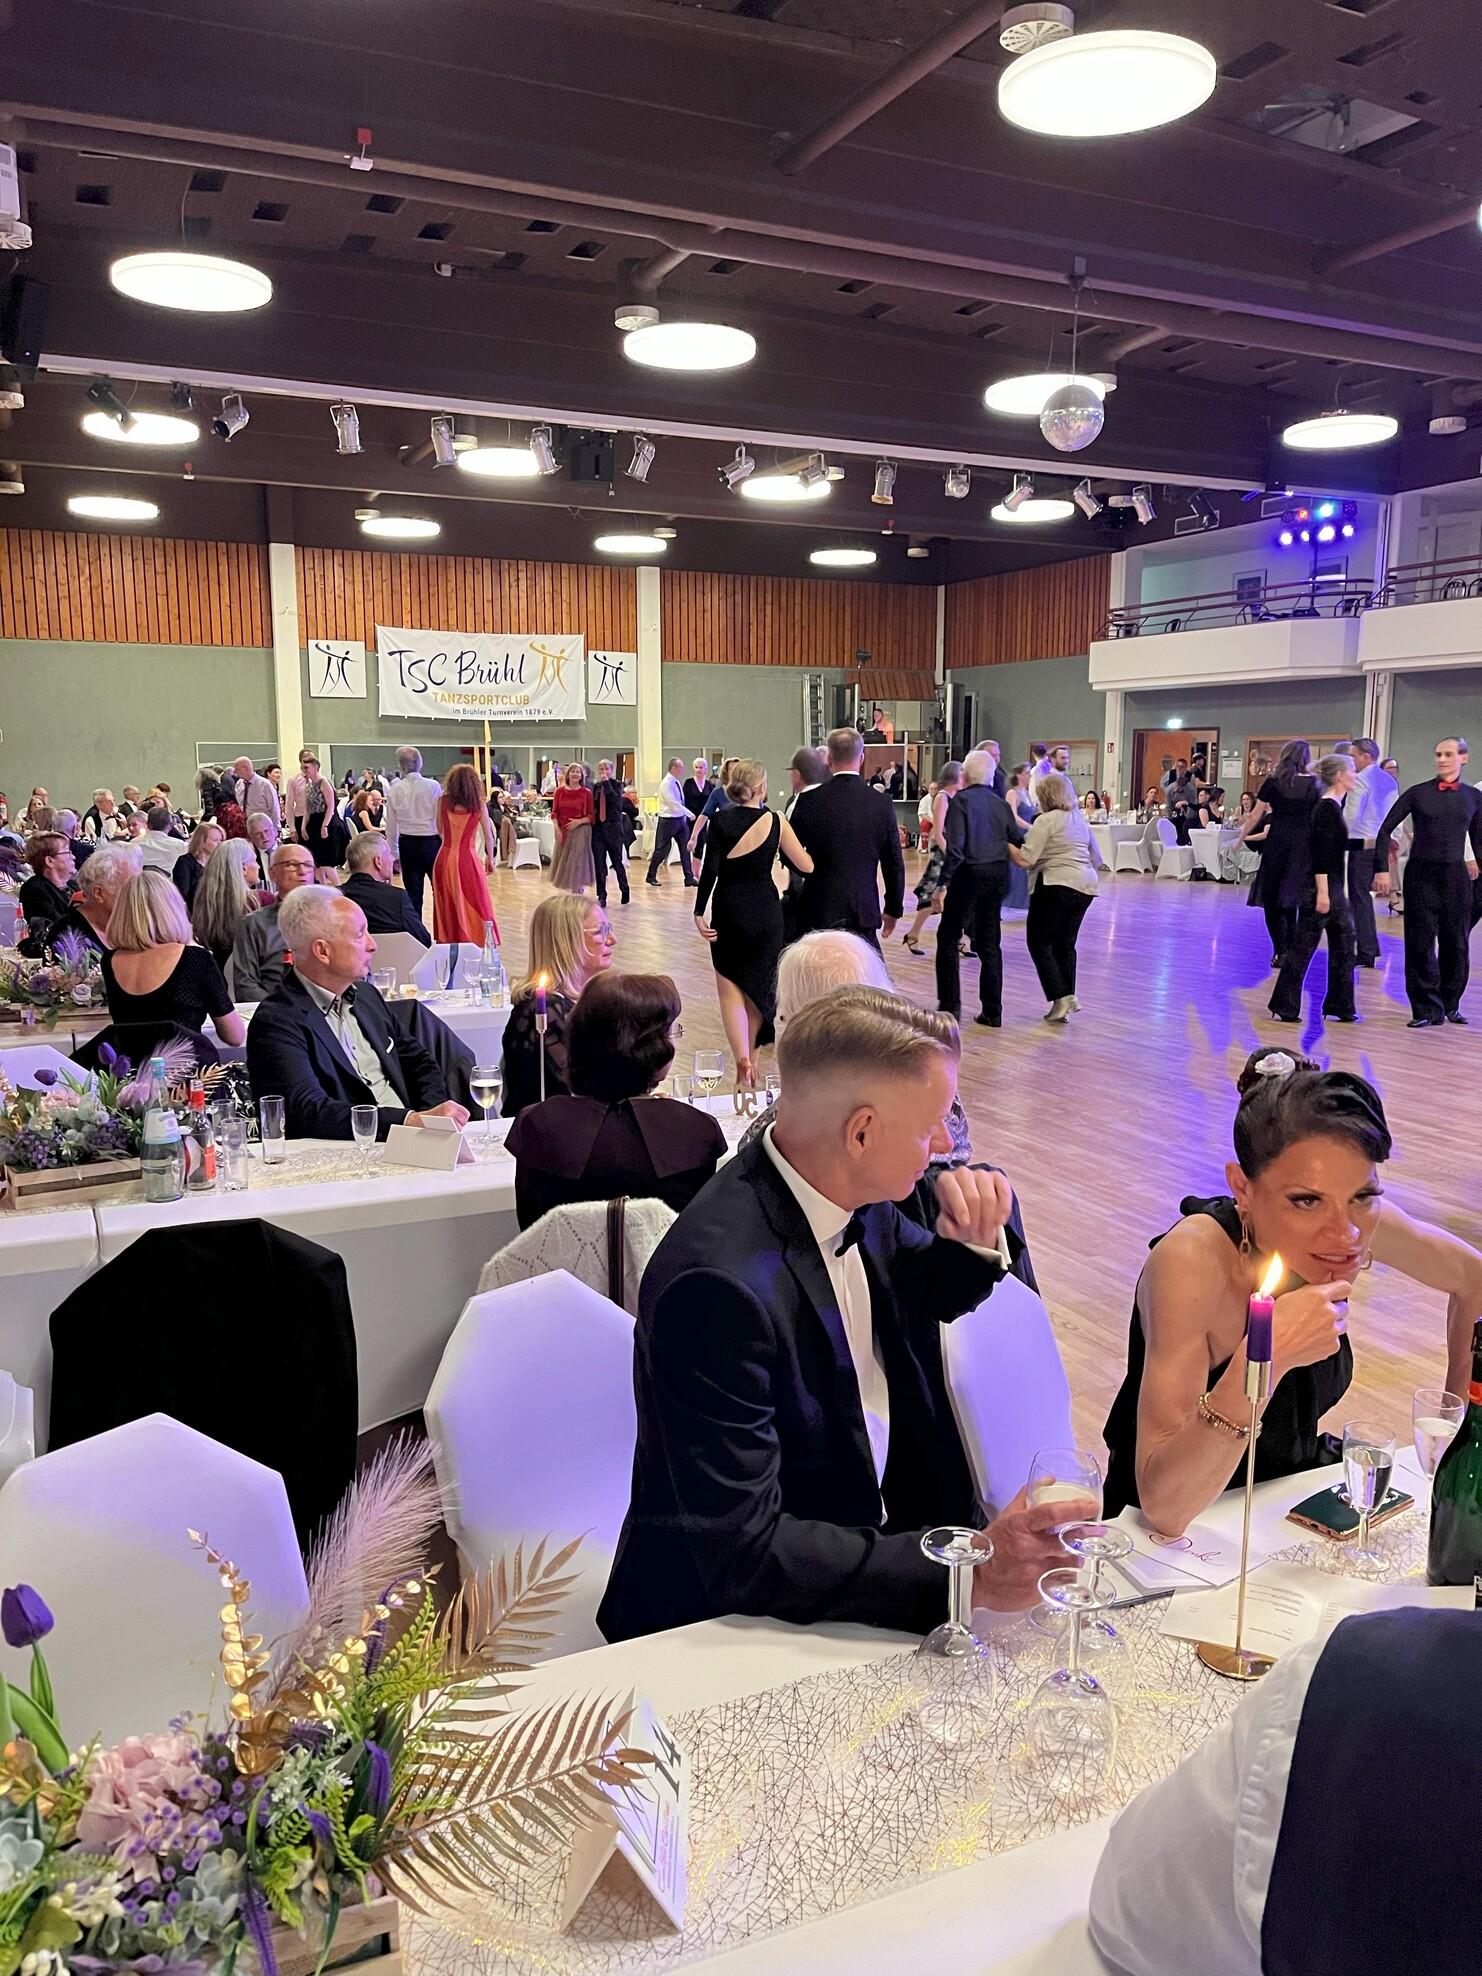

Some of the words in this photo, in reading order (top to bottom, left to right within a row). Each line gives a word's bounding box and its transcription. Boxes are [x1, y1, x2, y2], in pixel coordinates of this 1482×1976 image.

[387, 650, 447, 693] TSC
[454, 650, 528, 686] Brühl
[433, 692, 530, 706] TANZSPORTCLUB
[463, 708, 487, 716] Brühler
[488, 709, 523, 717] Turnverein
